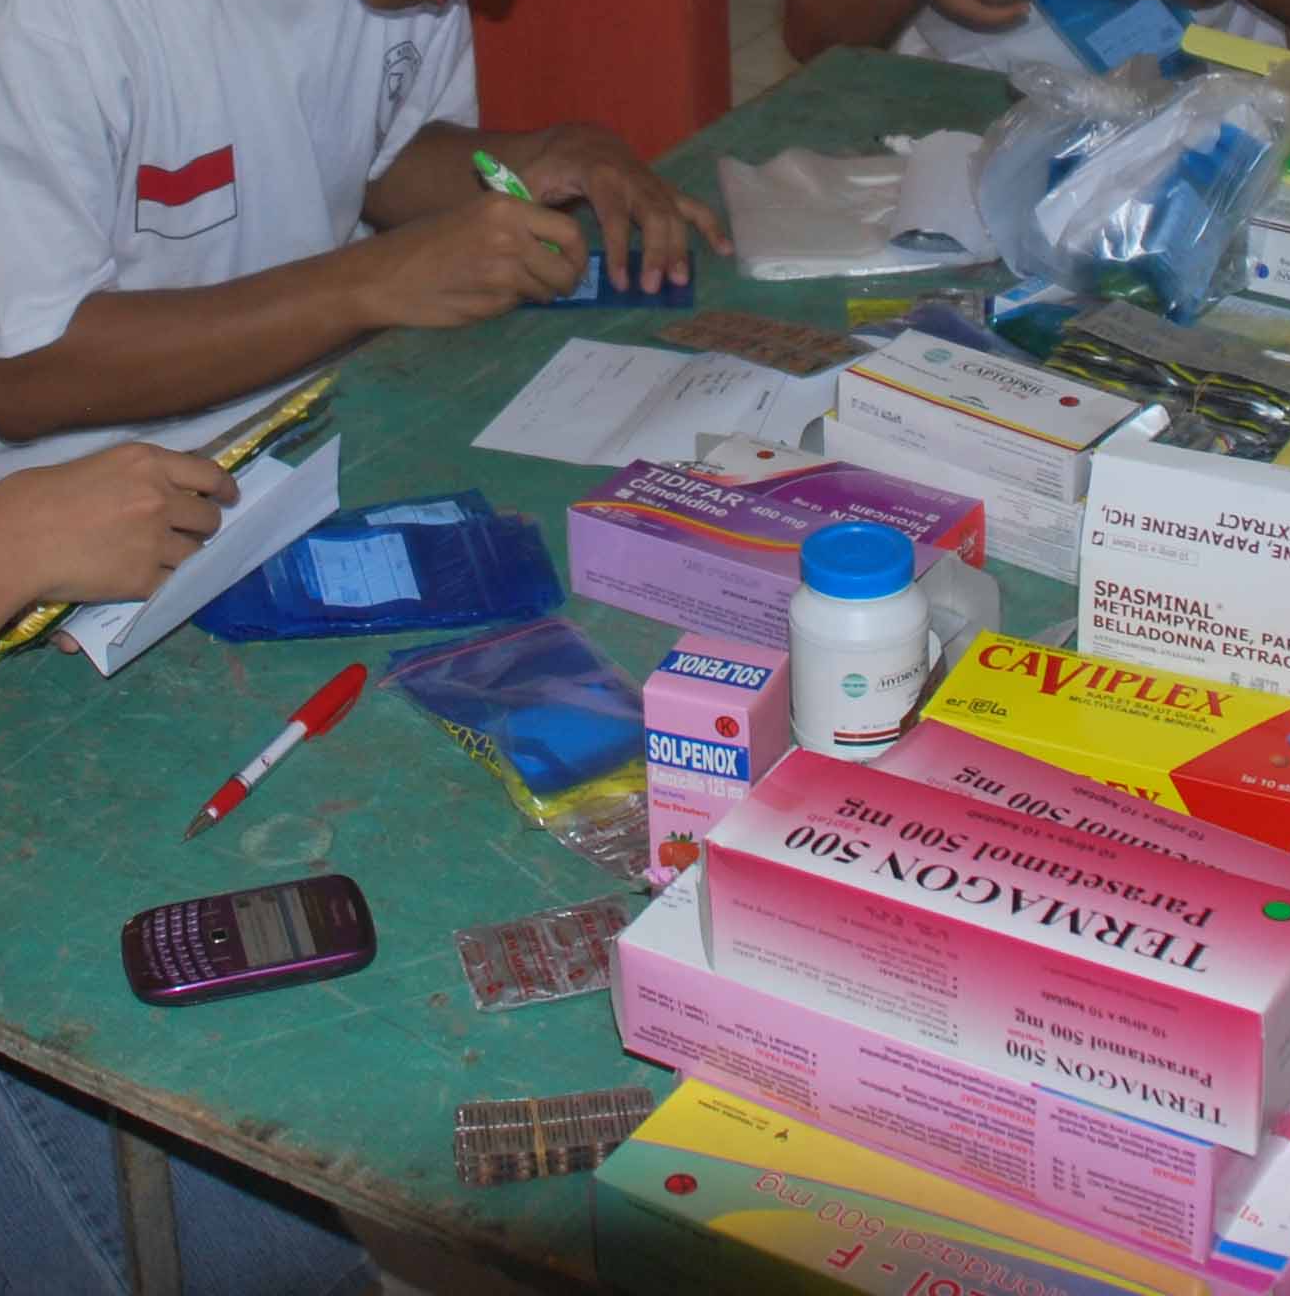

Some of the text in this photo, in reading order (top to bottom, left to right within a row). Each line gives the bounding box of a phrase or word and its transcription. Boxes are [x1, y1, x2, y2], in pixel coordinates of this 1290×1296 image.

[961, 362, 1045, 396] CAPTOPRIL
[629, 477, 729, 517] Cimetidine
[750, 505, 780, 520] 400
[780, 513, 809, 532] mg
[643, 467, 746, 508] TIDIFAR
[1140, 515, 1260, 555] PAPAVERINE
[1094, 579, 1215, 621] SPASMINAL
[1093, 615, 1216, 653] BELLADONNA
[1094, 597, 1254, 646] METHAMPYRONE,
[670, 654, 766, 687] SOLPENOX
[977, 643, 1235, 719] CAVIPLEX
[649, 732, 738, 777] SOLPENOX
[951, 766, 1005, 798] mg
[1261, 778, 1277, 790] 10
[1007, 792, 1070, 823] 500
[783, 824, 871, 864] 500
[834, 797, 1214, 928] Parasetamol 500 mg
[870, 850, 1209, 974] TERMAGON
[1014, 1008, 1213, 1089] Parasetamol 500 mg
[1005, 1038, 1227, 1129] TERMAGON 500
[755, 1172, 812, 1208] mg
[816, 1198, 885, 1238] 500
[826, 1241, 865, 1270] F
